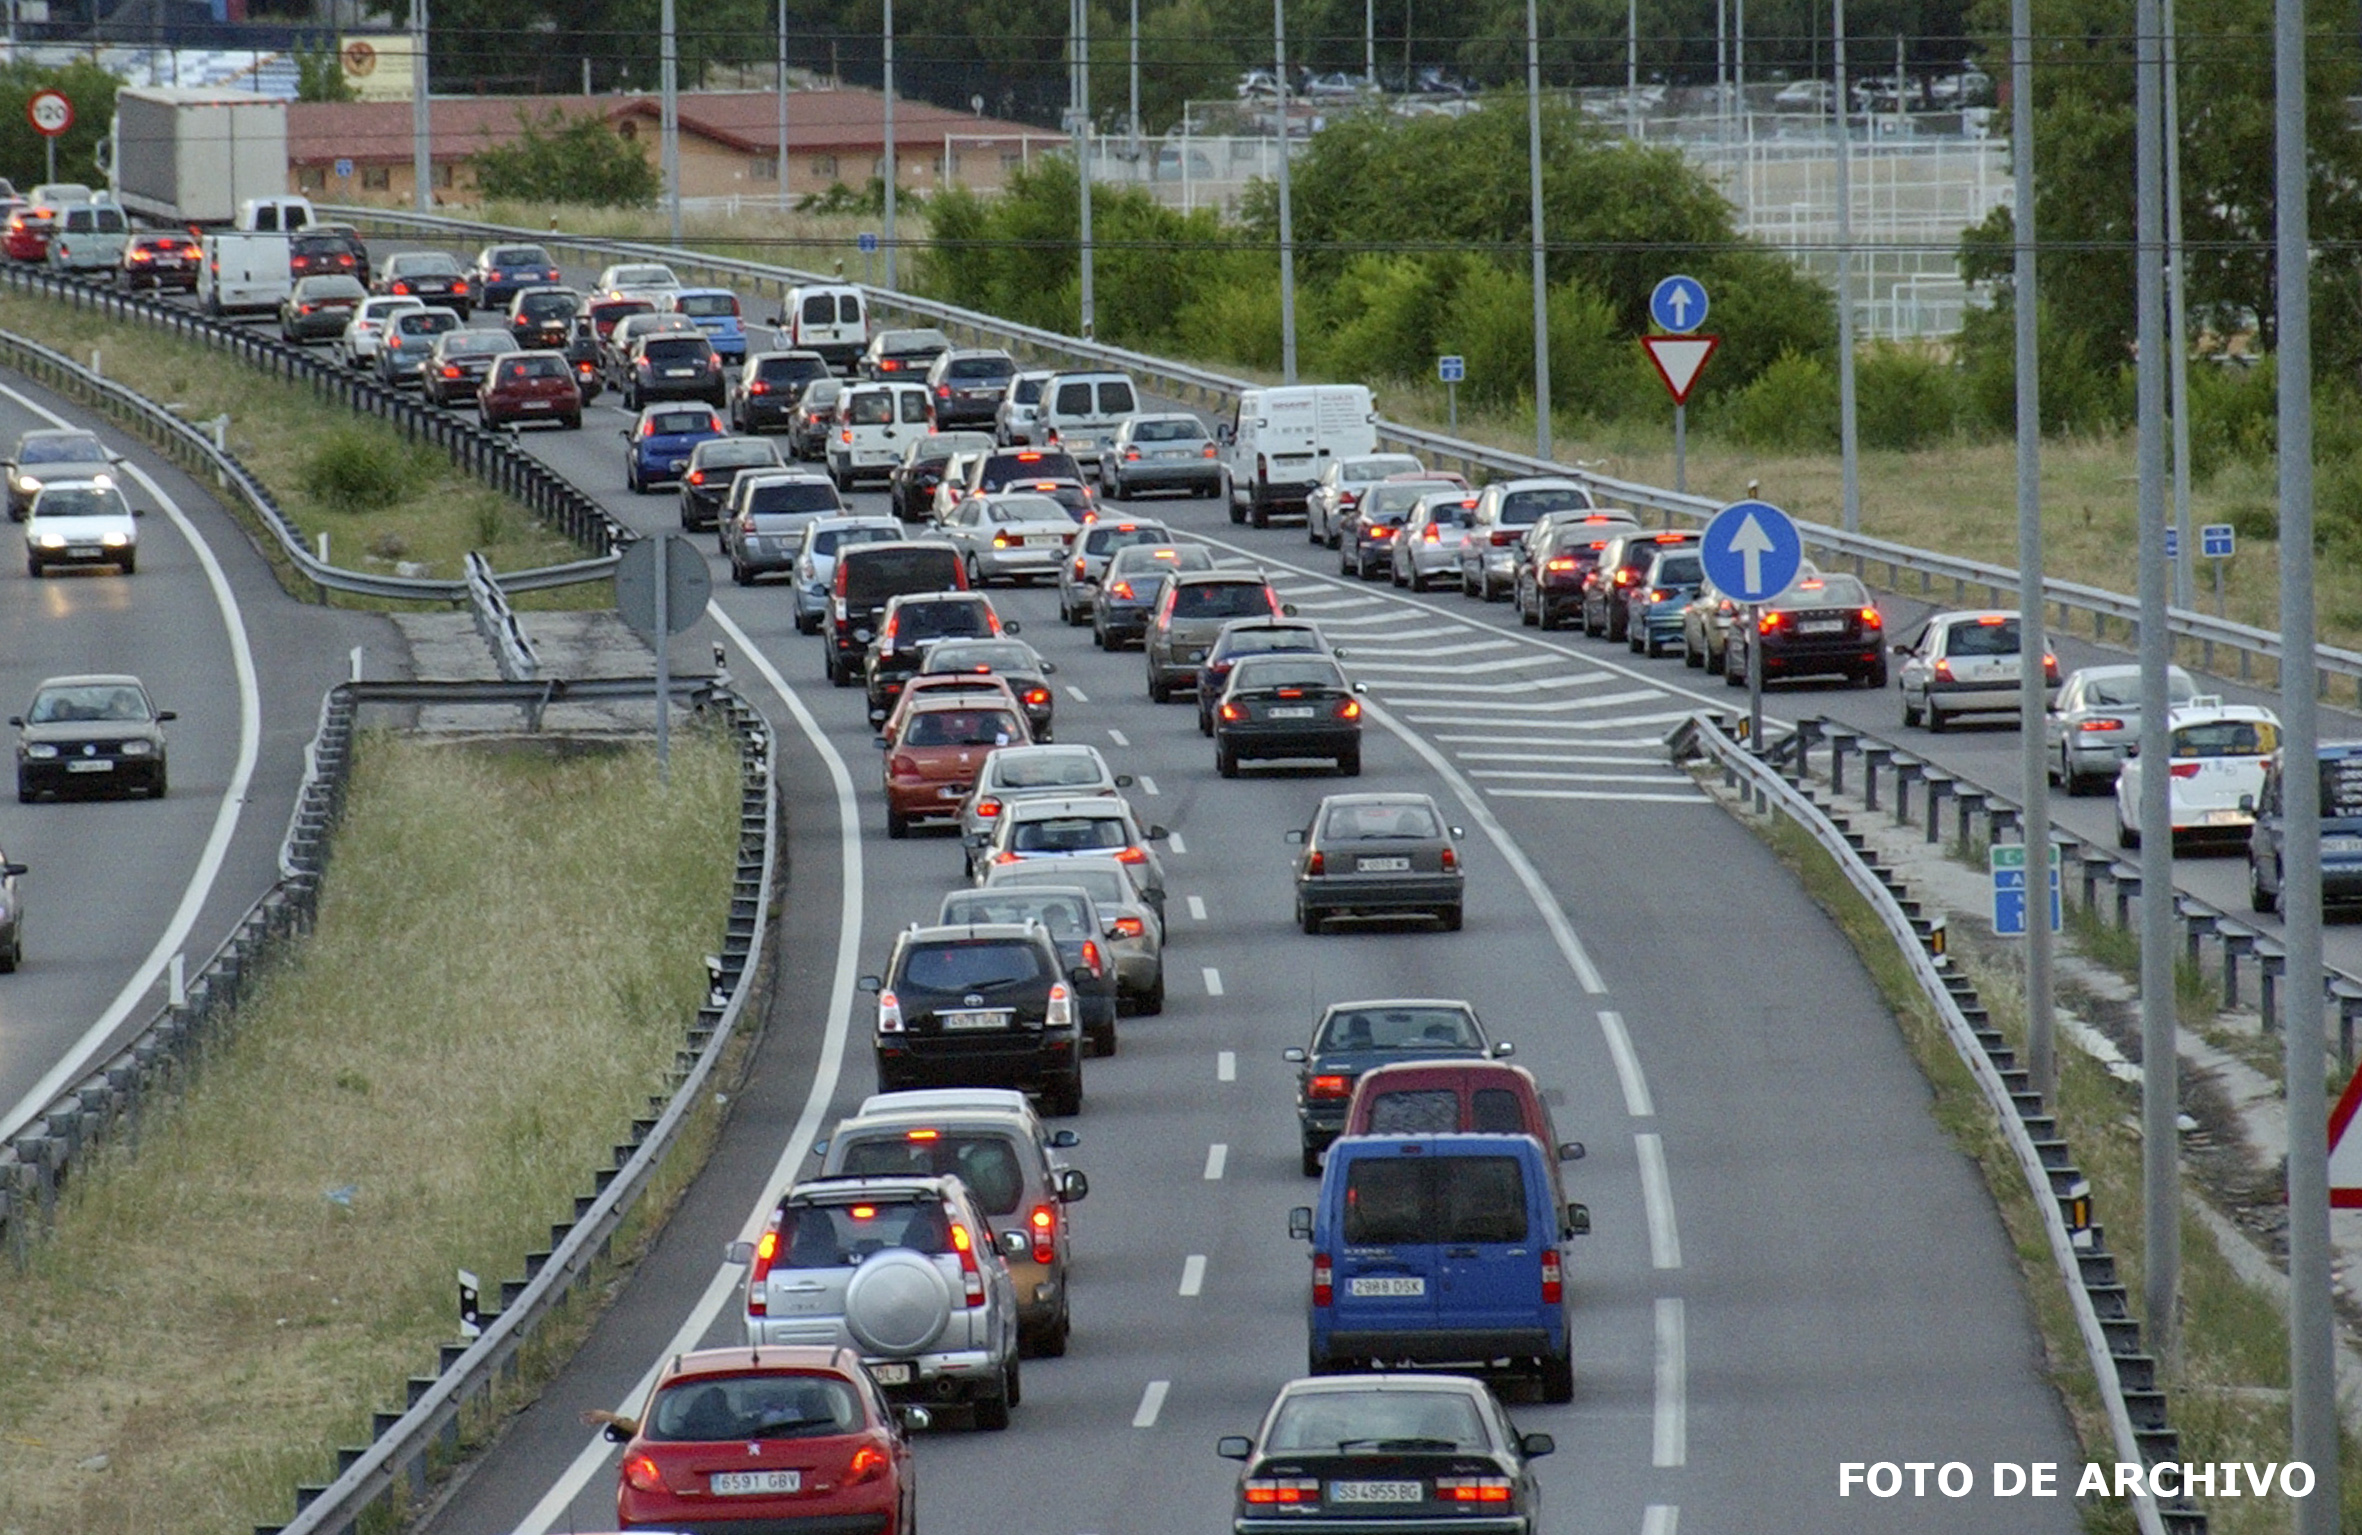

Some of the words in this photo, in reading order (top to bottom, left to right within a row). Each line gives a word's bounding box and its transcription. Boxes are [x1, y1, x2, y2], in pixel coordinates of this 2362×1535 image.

[36, 103, 67, 121] 120
[721, 1475, 760, 1490] 6591
[767, 1473, 798, 1488] GBV
[1360, 1484, 1397, 1499] 4955
[1399, 1484, 1419, 1499] BG
